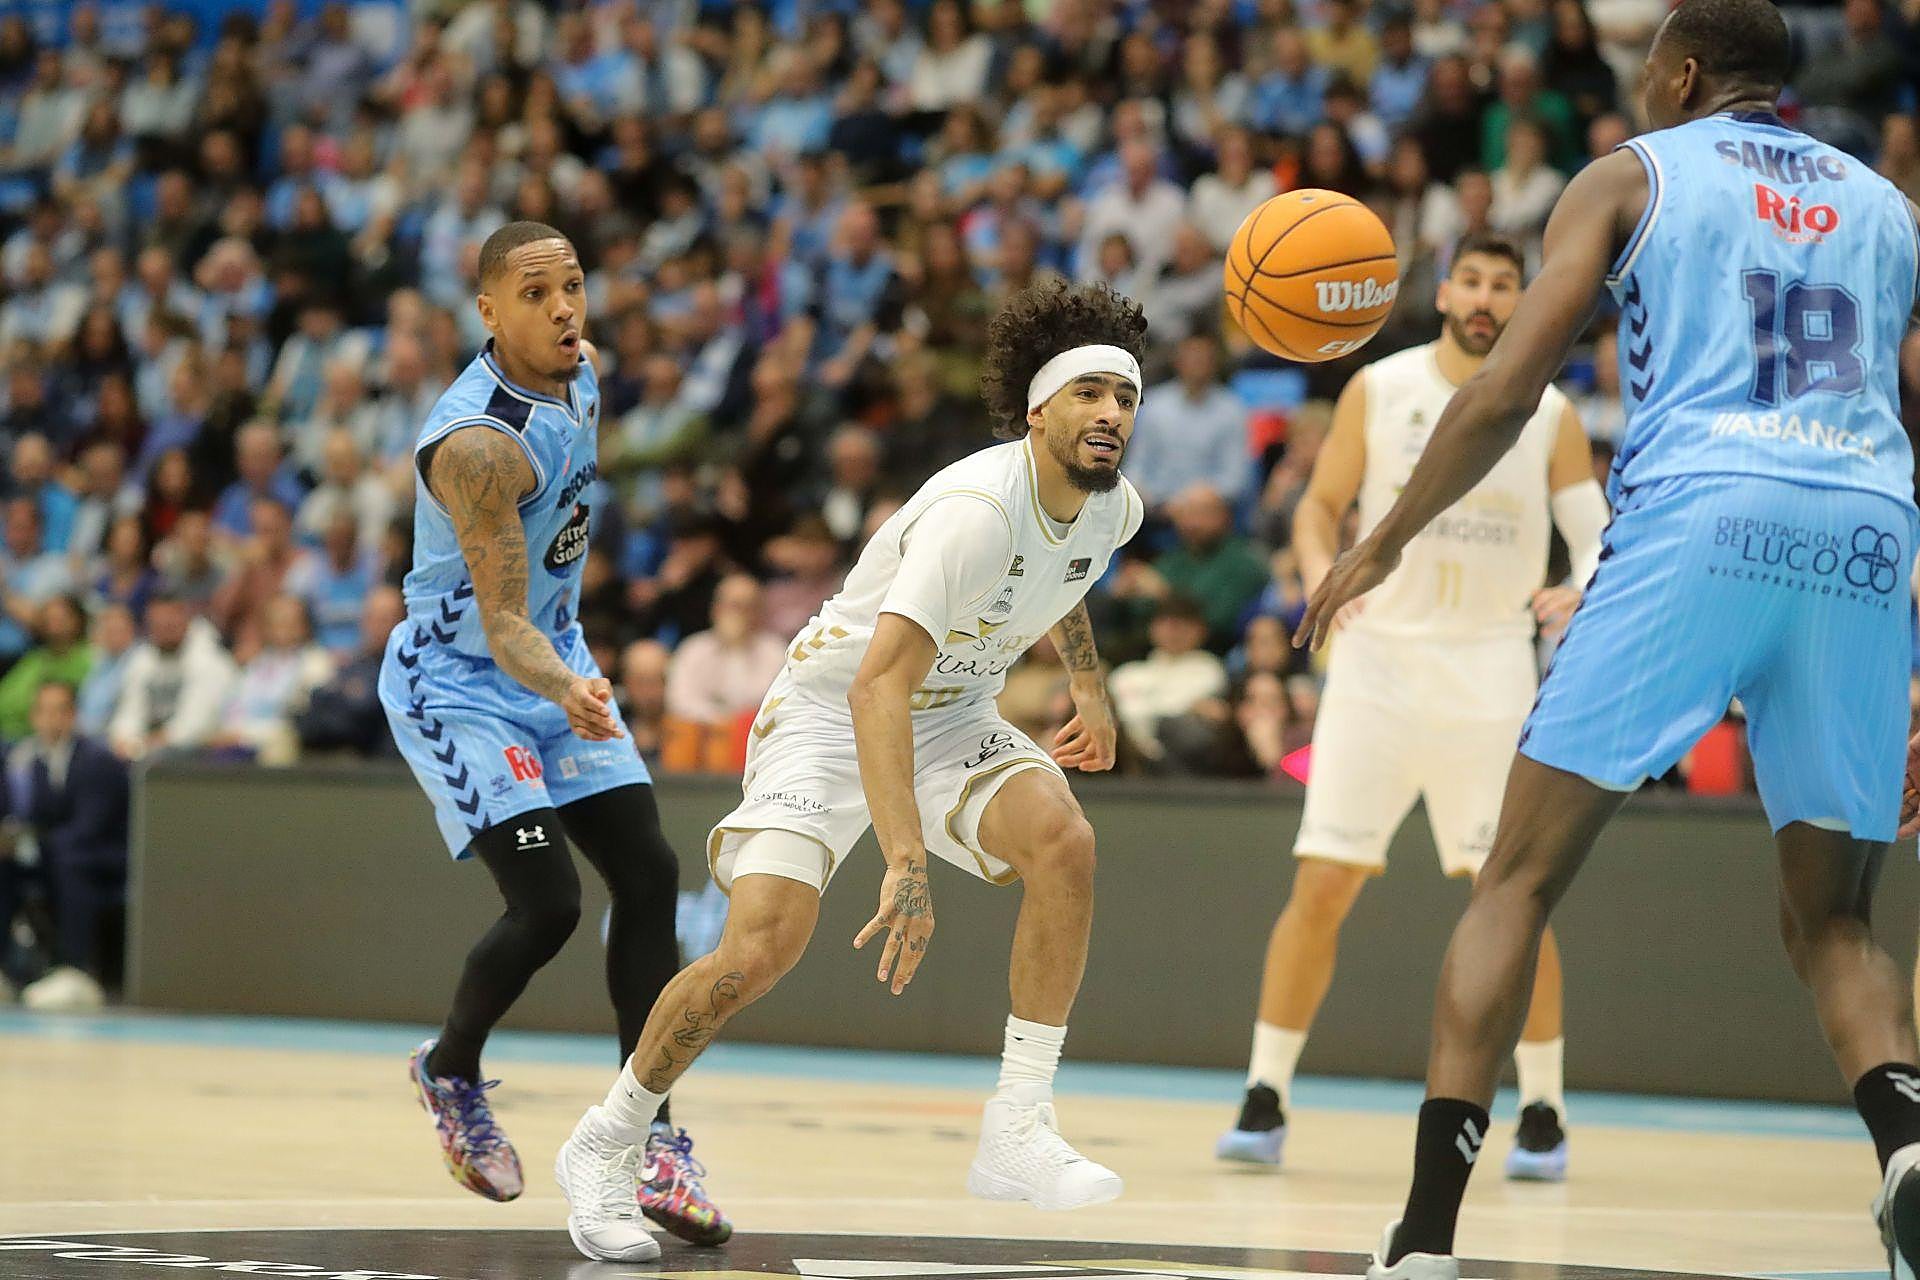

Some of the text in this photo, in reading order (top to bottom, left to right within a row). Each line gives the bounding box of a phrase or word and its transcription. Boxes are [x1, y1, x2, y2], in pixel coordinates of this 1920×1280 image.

[1714, 139, 1847, 184] SAKHO
[1741, 268, 1867, 408] 18
[1708, 565, 1890, 611] VICEPRESIDENCIA
[803, 796, 810, 806] Y
